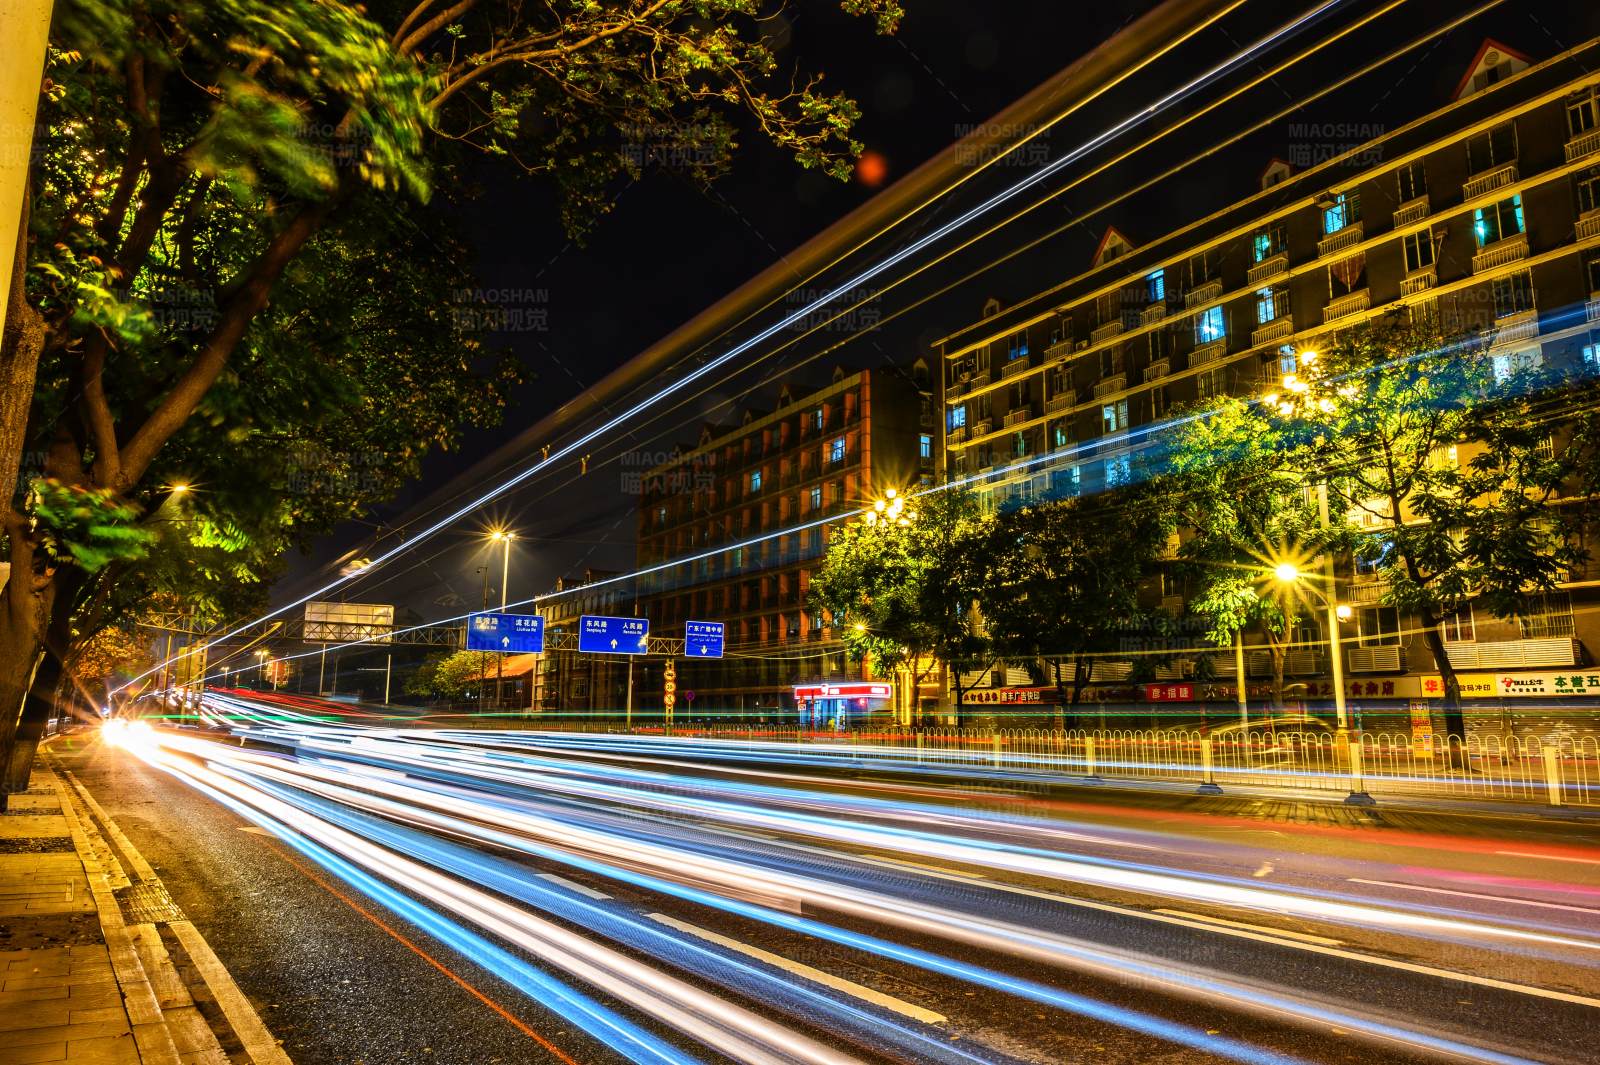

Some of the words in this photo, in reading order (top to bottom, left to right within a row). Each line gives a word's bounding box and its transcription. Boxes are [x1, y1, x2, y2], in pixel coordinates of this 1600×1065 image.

[586, 620, 607, 628] 东风路
[622, 622, 643, 630] 人民路
